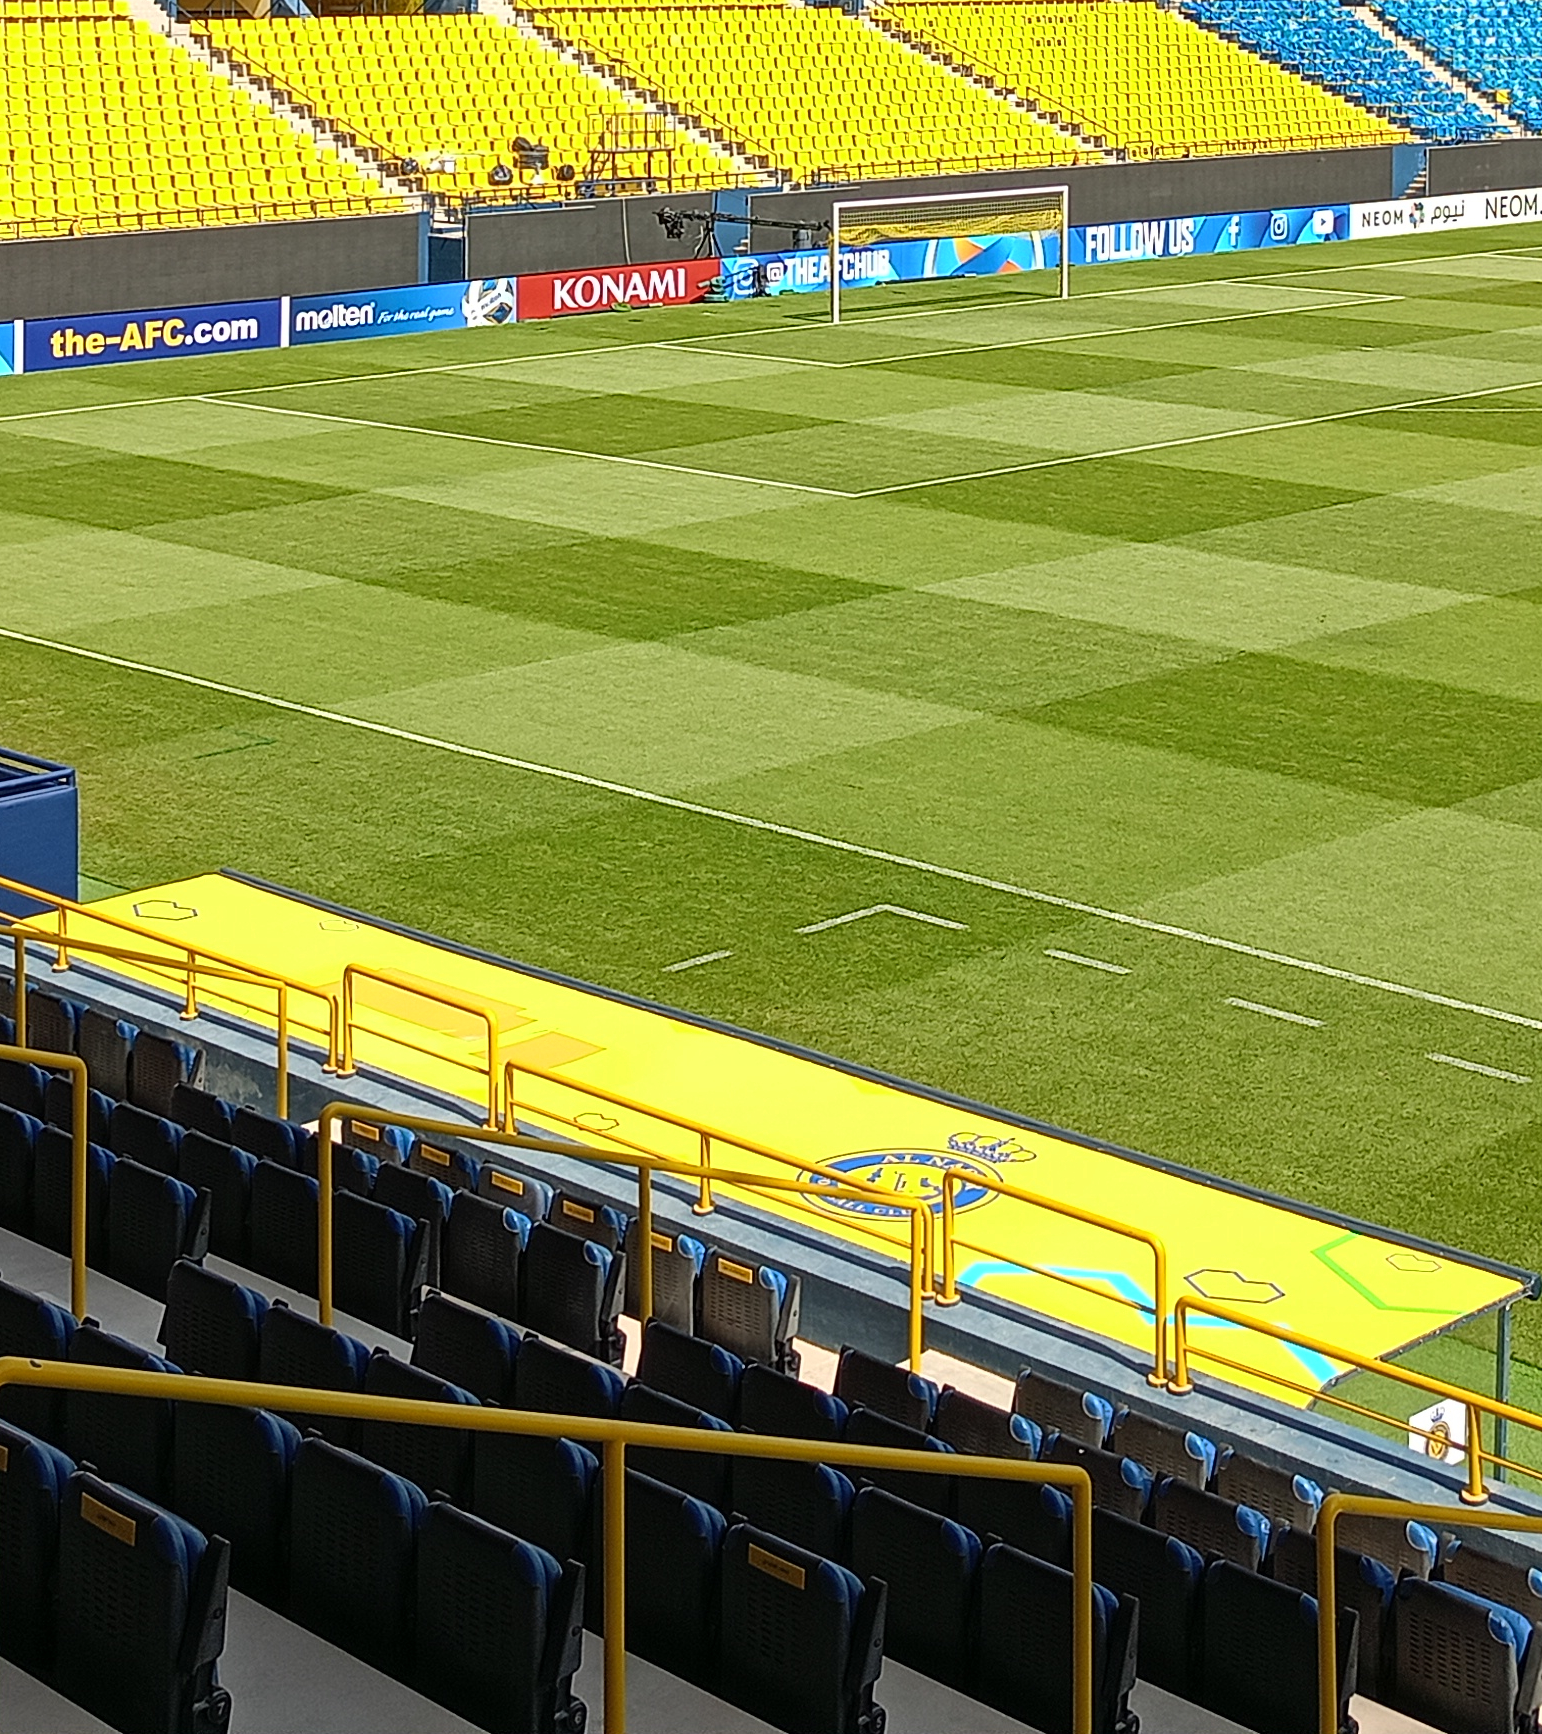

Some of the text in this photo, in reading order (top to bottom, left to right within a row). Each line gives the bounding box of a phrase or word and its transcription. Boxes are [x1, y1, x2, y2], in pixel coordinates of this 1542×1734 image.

[1362, 209, 1404, 228] NEOM
[1085, 217, 1195, 263] FOLLOW US
[553, 268, 686, 310] KONAMI
[295, 302, 375, 331] molten
[50, 318, 259, 358] the-AFC.com
[217, 1702, 226, 1716] 7
